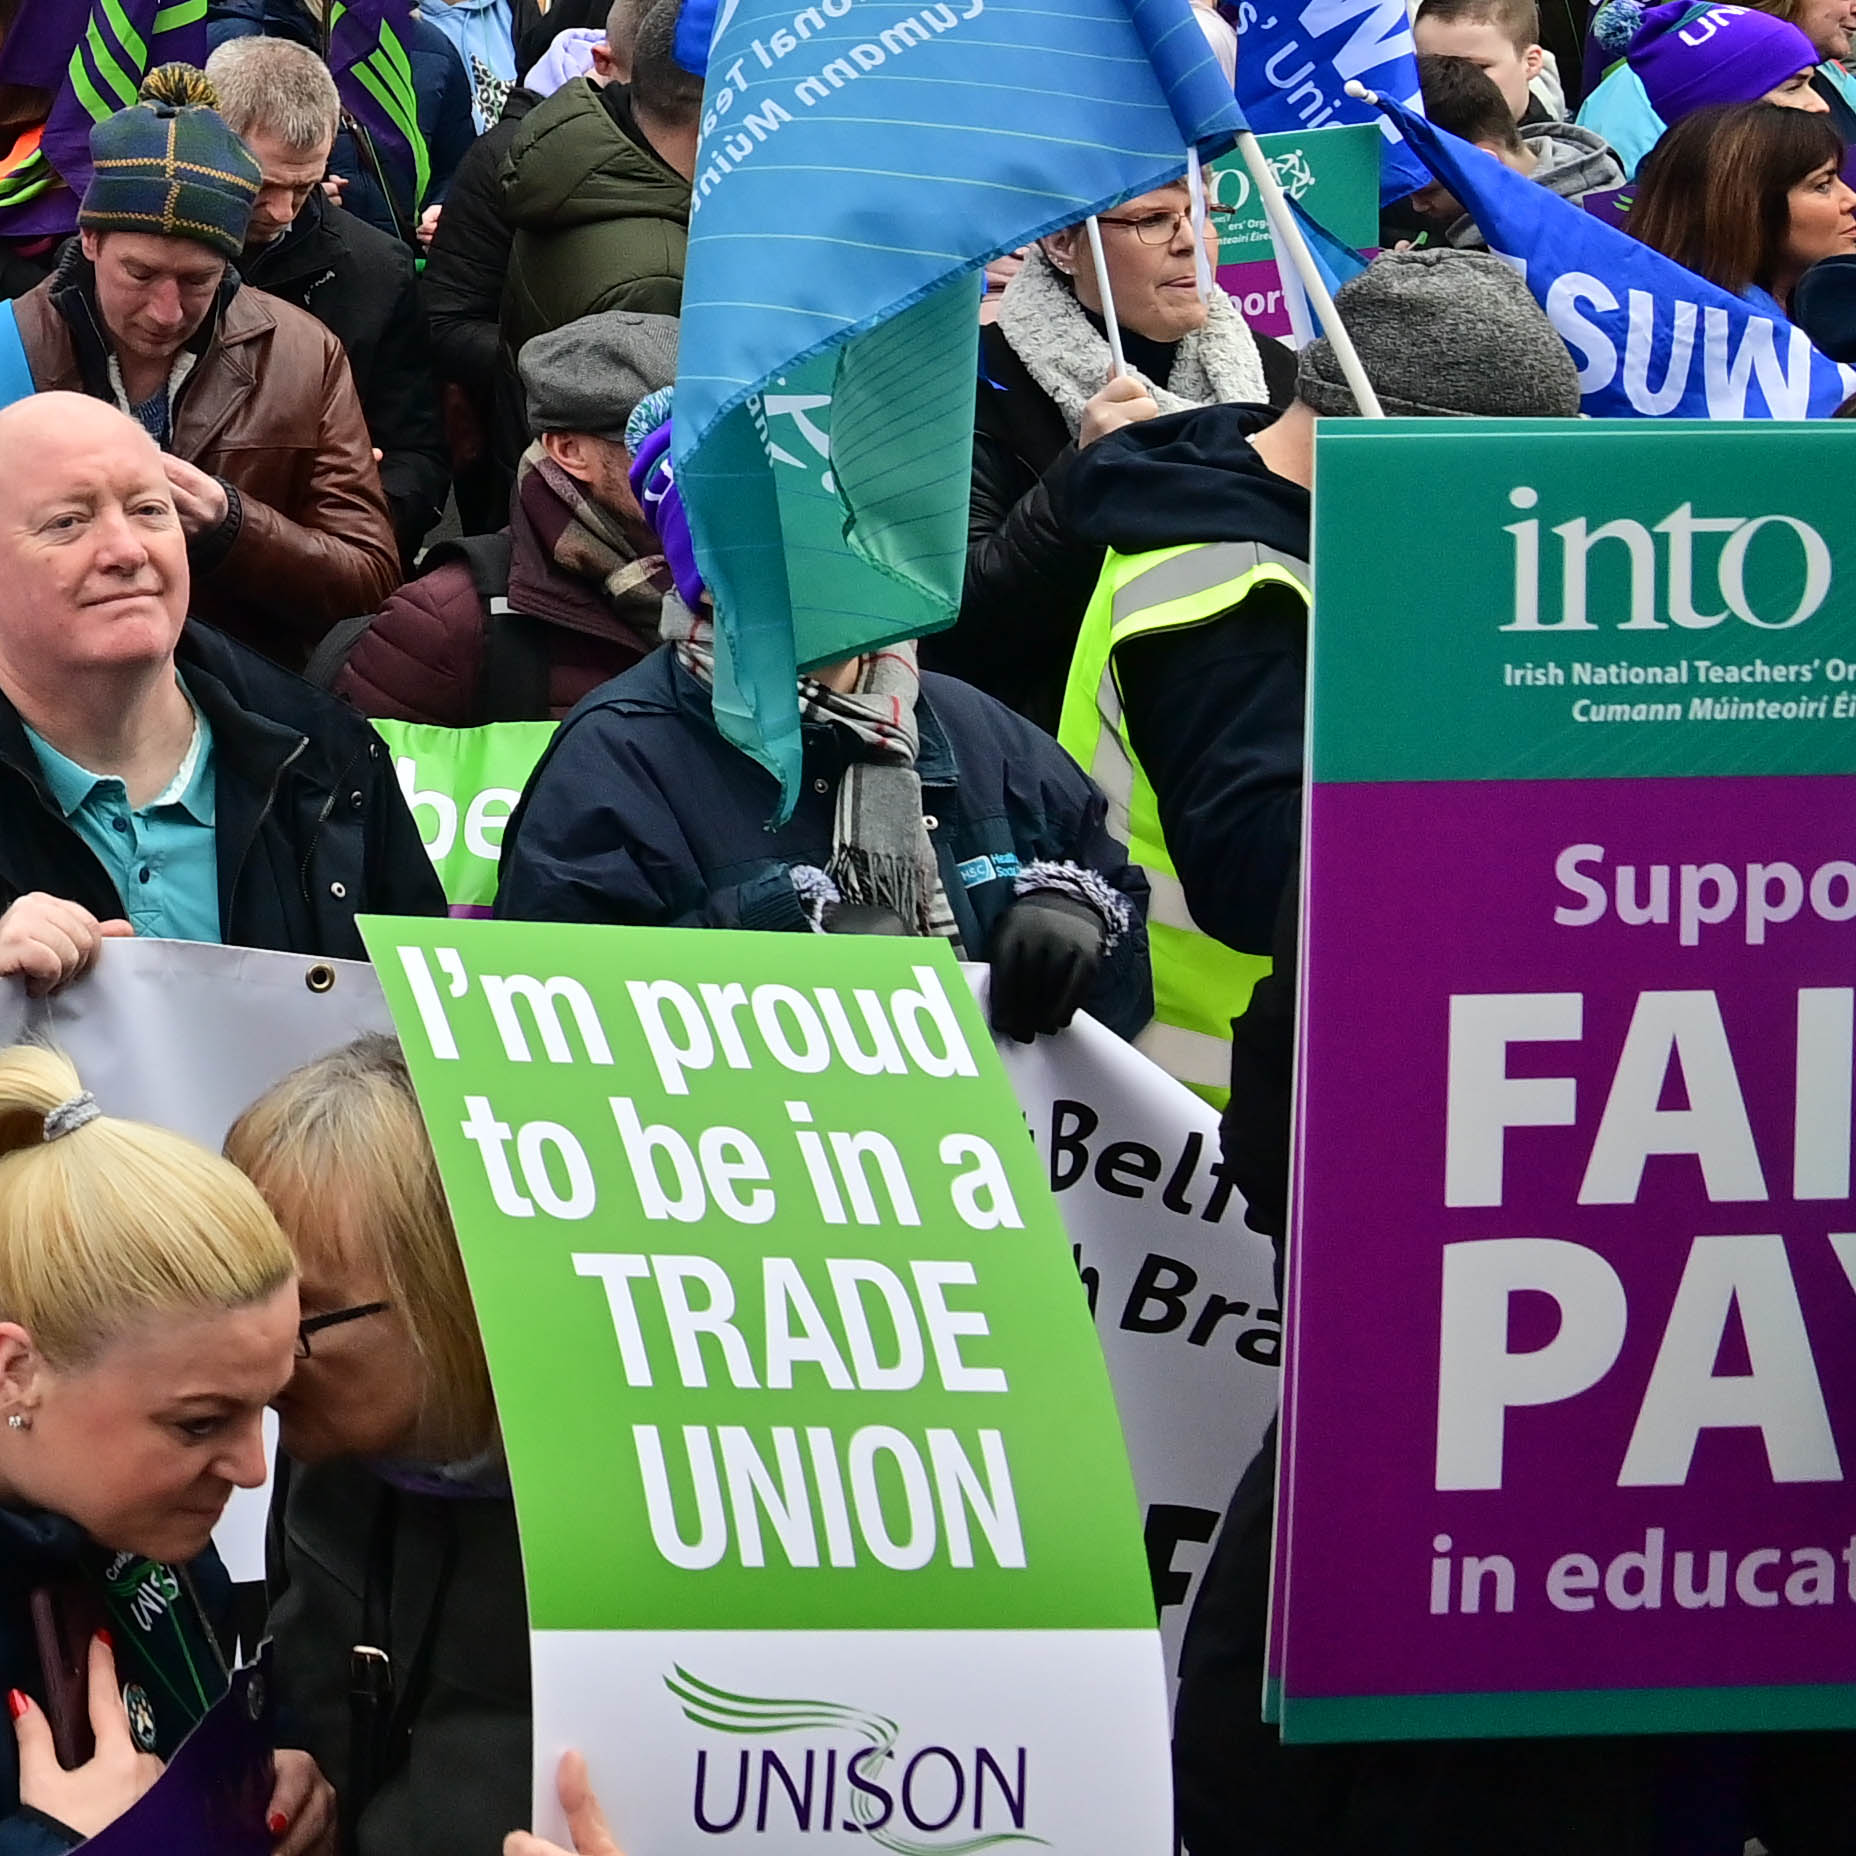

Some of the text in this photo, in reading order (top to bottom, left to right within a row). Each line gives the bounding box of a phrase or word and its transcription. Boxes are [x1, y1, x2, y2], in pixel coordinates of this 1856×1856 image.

[1498, 485, 1833, 633] into
[1502, 661, 1564, 688] Irish
[1570, 659, 1689, 687] National
[1693, 658, 1819, 686] Teachers'
[1570, 697, 1683, 724] Cumann
[1688, 689, 1828, 723] Múinteoirí
[394, 944, 980, 1094] I'm proud
[460, 1094, 1026, 1231] to be in a
[570, 1252, 1010, 1393] TRADE
[631, 1424, 1028, 1570] UNION
[1428, 1533, 1518, 1615] in
[692, 1745, 1028, 1834] UNISON
